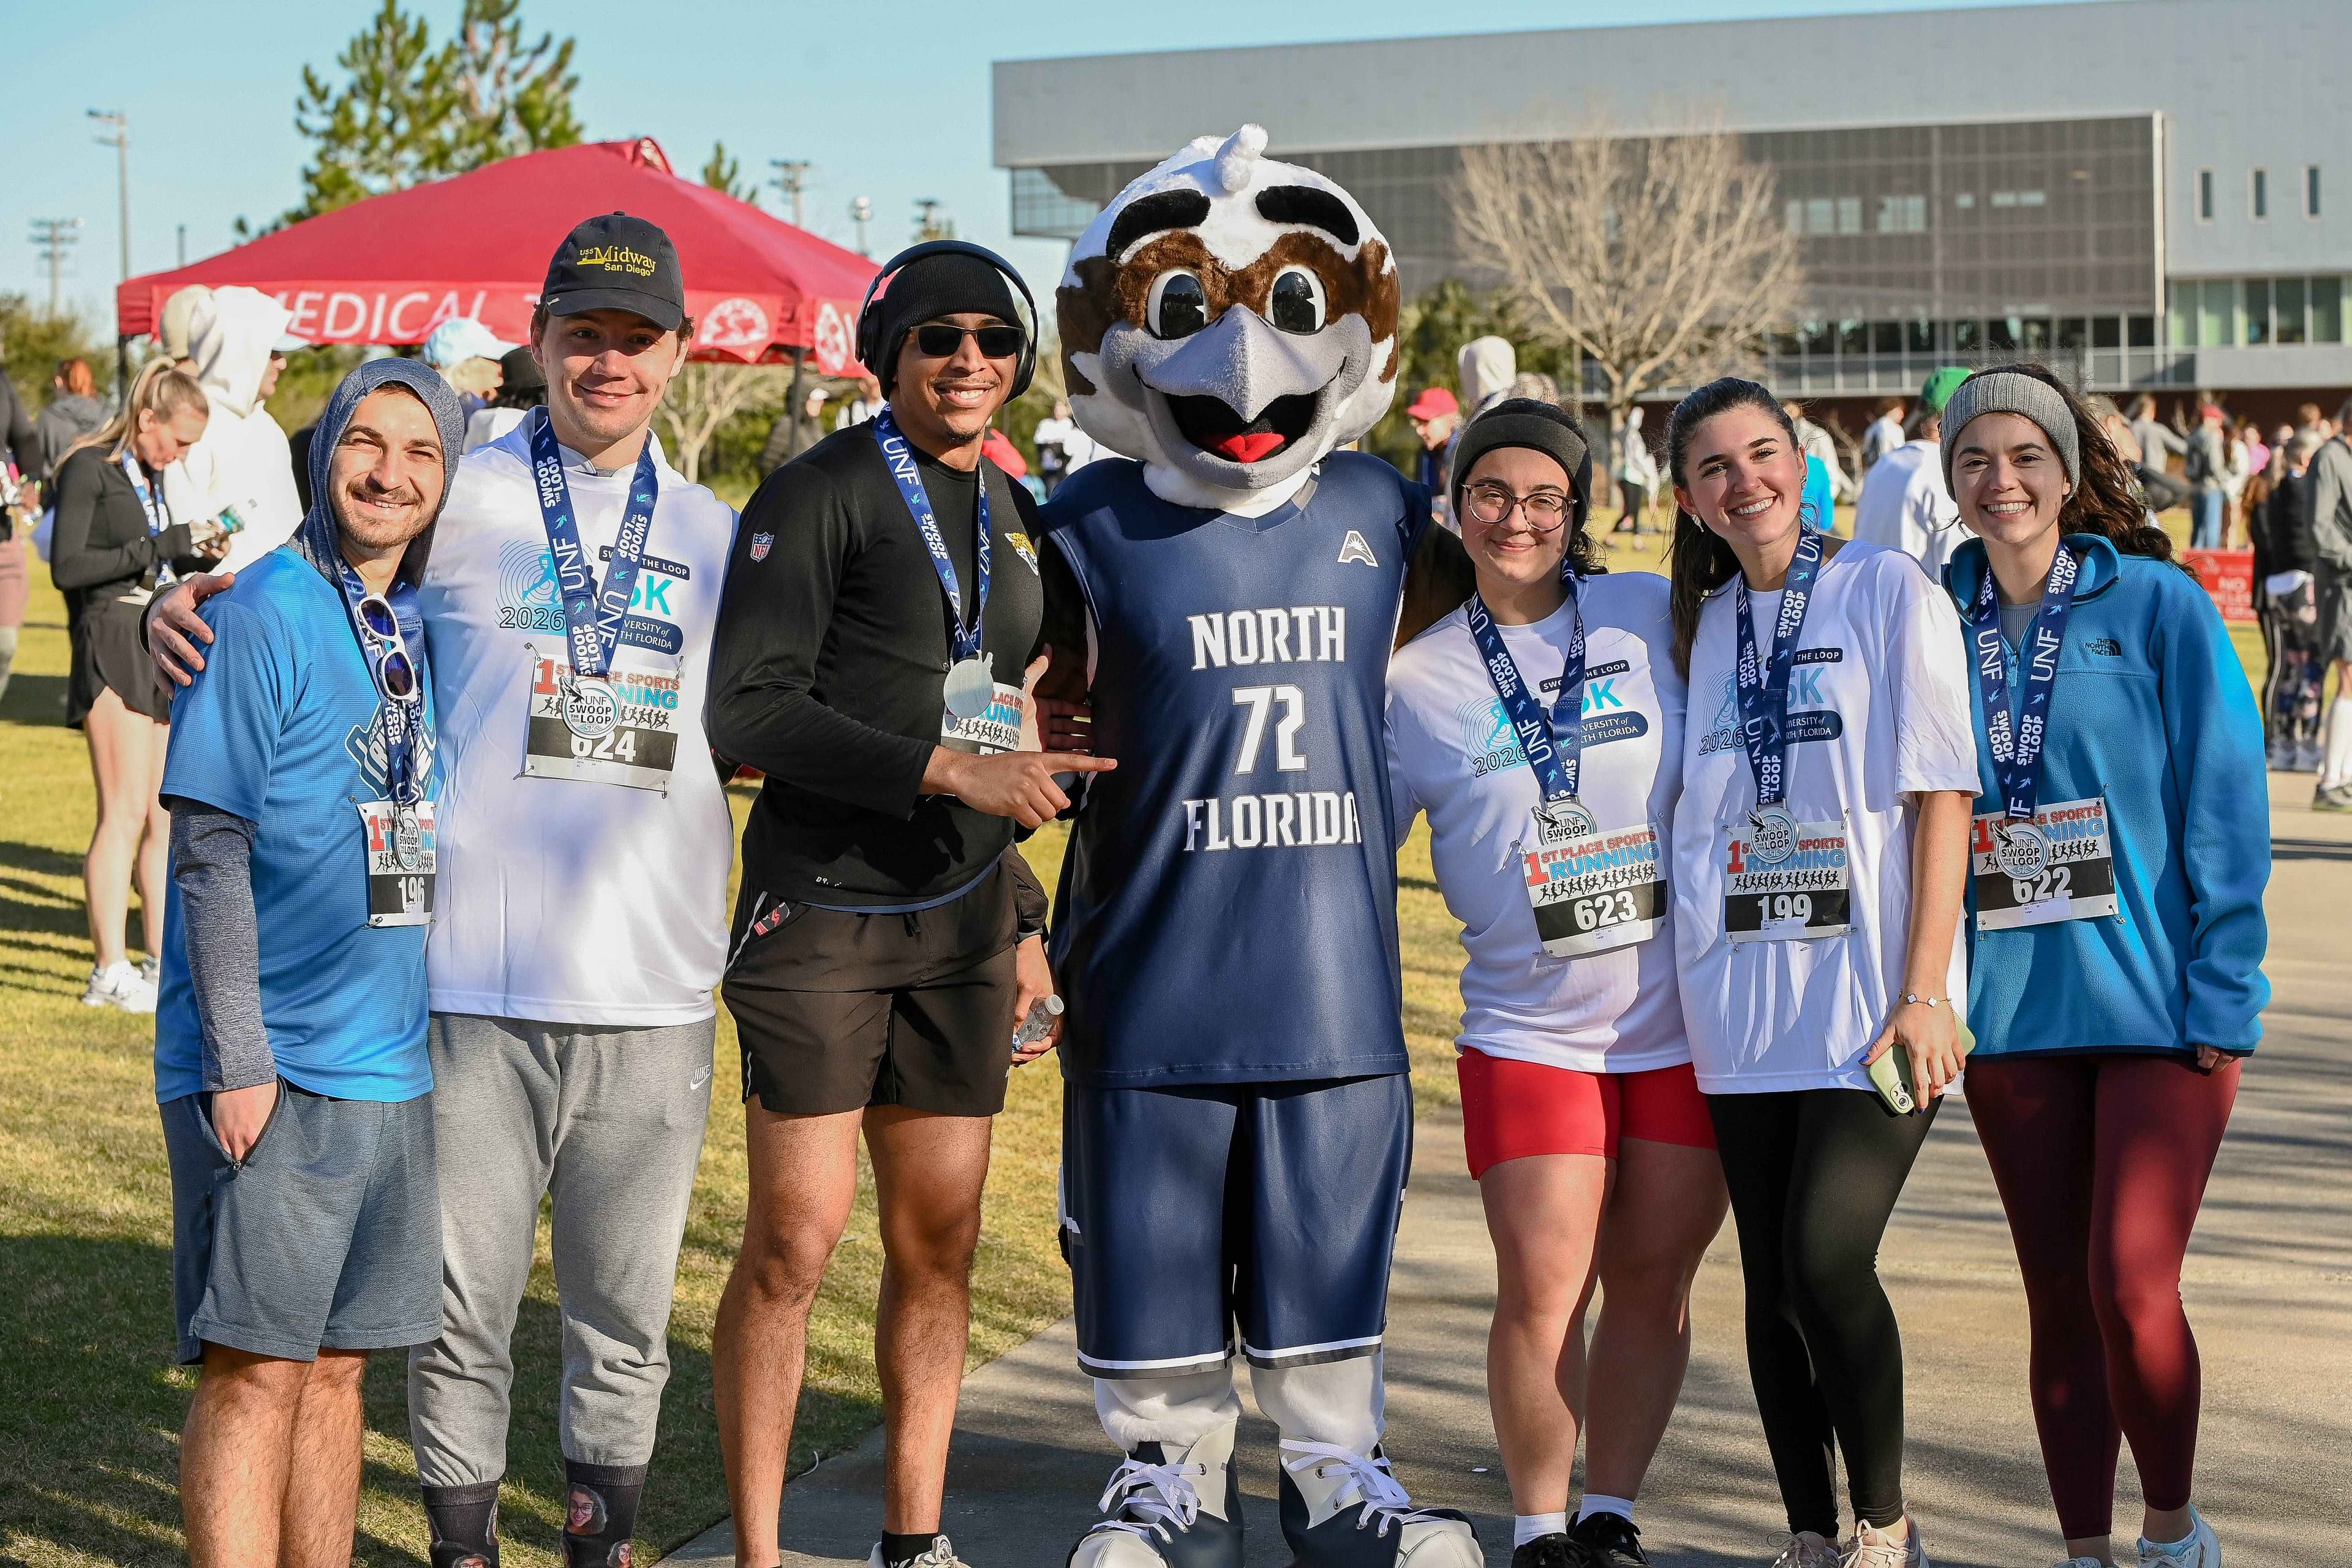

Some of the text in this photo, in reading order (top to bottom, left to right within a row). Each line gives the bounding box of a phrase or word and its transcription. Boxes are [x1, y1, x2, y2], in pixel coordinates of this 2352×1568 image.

[594, 246, 656, 273] Midway
[604, 262, 650, 276] San Diego
[546, 456, 564, 494] LOOP
[883, 435, 920, 486] UNF
[537, 460, 556, 508] SWOOP
[617, 521, 635, 558] LOOP
[630, 513, 648, 562] SWOOP
[754, 545, 768, 558] NFL
[921, 526, 941, 559] LOOP
[924, 513, 949, 560] SWOOP
[552, 537, 584, 592] UNF
[663, 562, 687, 576] LOOP
[2048, 550, 2068, 594] SWOOP
[499, 606, 565, 631] 2026
[597, 589, 628, 649] UNF
[1777, 589, 1794, 638] SWOOP
[1790, 591, 1806, 627] LOOP
[583, 624, 601, 663] LOOP
[624, 619, 670, 638] VERSITY of
[636, 633, 672, 649] FLORIDA
[1186, 606, 1346, 671] NORTH
[1746, 640, 1757, 685] SWOOP
[1796, 653, 1812, 662] THE
[1977, 627, 2002, 680] UNF
[2030, 627, 2060, 682] UNF
[627, 673, 680, 690] SPORTS
[1488, 658, 1514, 699] SWOOP
[1497, 652, 1517, 686] LOOP
[1601, 663, 1626, 675] LOOP
[1739, 656, 1747, 689] LOOP
[569, 704, 611, 715] SWOOP
[586, 696, 607, 705] UNF
[992, 690, 1014, 706] LACE
[581, 715, 611, 724] LOOP
[1232, 683, 1307, 775] 72
[1598, 726, 1638, 739] FLORIDA
[1621, 717, 1629, 725] of
[1800, 727, 1831, 737] FLORIDA
[1819, 716, 1826, 726] of
[2029, 715, 2044, 753] LOOP
[1517, 719, 1552, 766] UNF
[1698, 726, 1745, 756] 2026
[1989, 725, 2005, 763] LOOP
[1997, 710, 2014, 760] SWOOP
[2016, 714, 2034, 766] SWOOP
[1472, 744, 1528, 777] 2026
[1770, 755, 1781, 791] LOOP
[1559, 816, 1580, 827] UNF
[1766, 821, 1784, 832] UNF
[2050, 805, 2103, 822] SPORTS
[399, 835, 418, 846] SWOOP
[1547, 824, 1586, 839] SWOOP
[1561, 842, 1604, 861] PLACE
[1607, 830, 1657, 849] SPORTS
[1755, 830, 1789, 842] SWOOP
[1765, 839, 1789, 850] LOOP
[1798, 837, 1845, 851] SPORTS
[2015, 839, 2035, 848] UNF
[404, 846, 418, 856] LOOP
[1550, 842, 1660, 881] RUNNING
[2002, 848, 2040, 857] SWOOP
[2013, 857, 2040, 865] LOOP
[2013, 867, 2073, 903] 622
[1574, 890, 1637, 930] 623
[1757, 894, 1812, 924] 199
